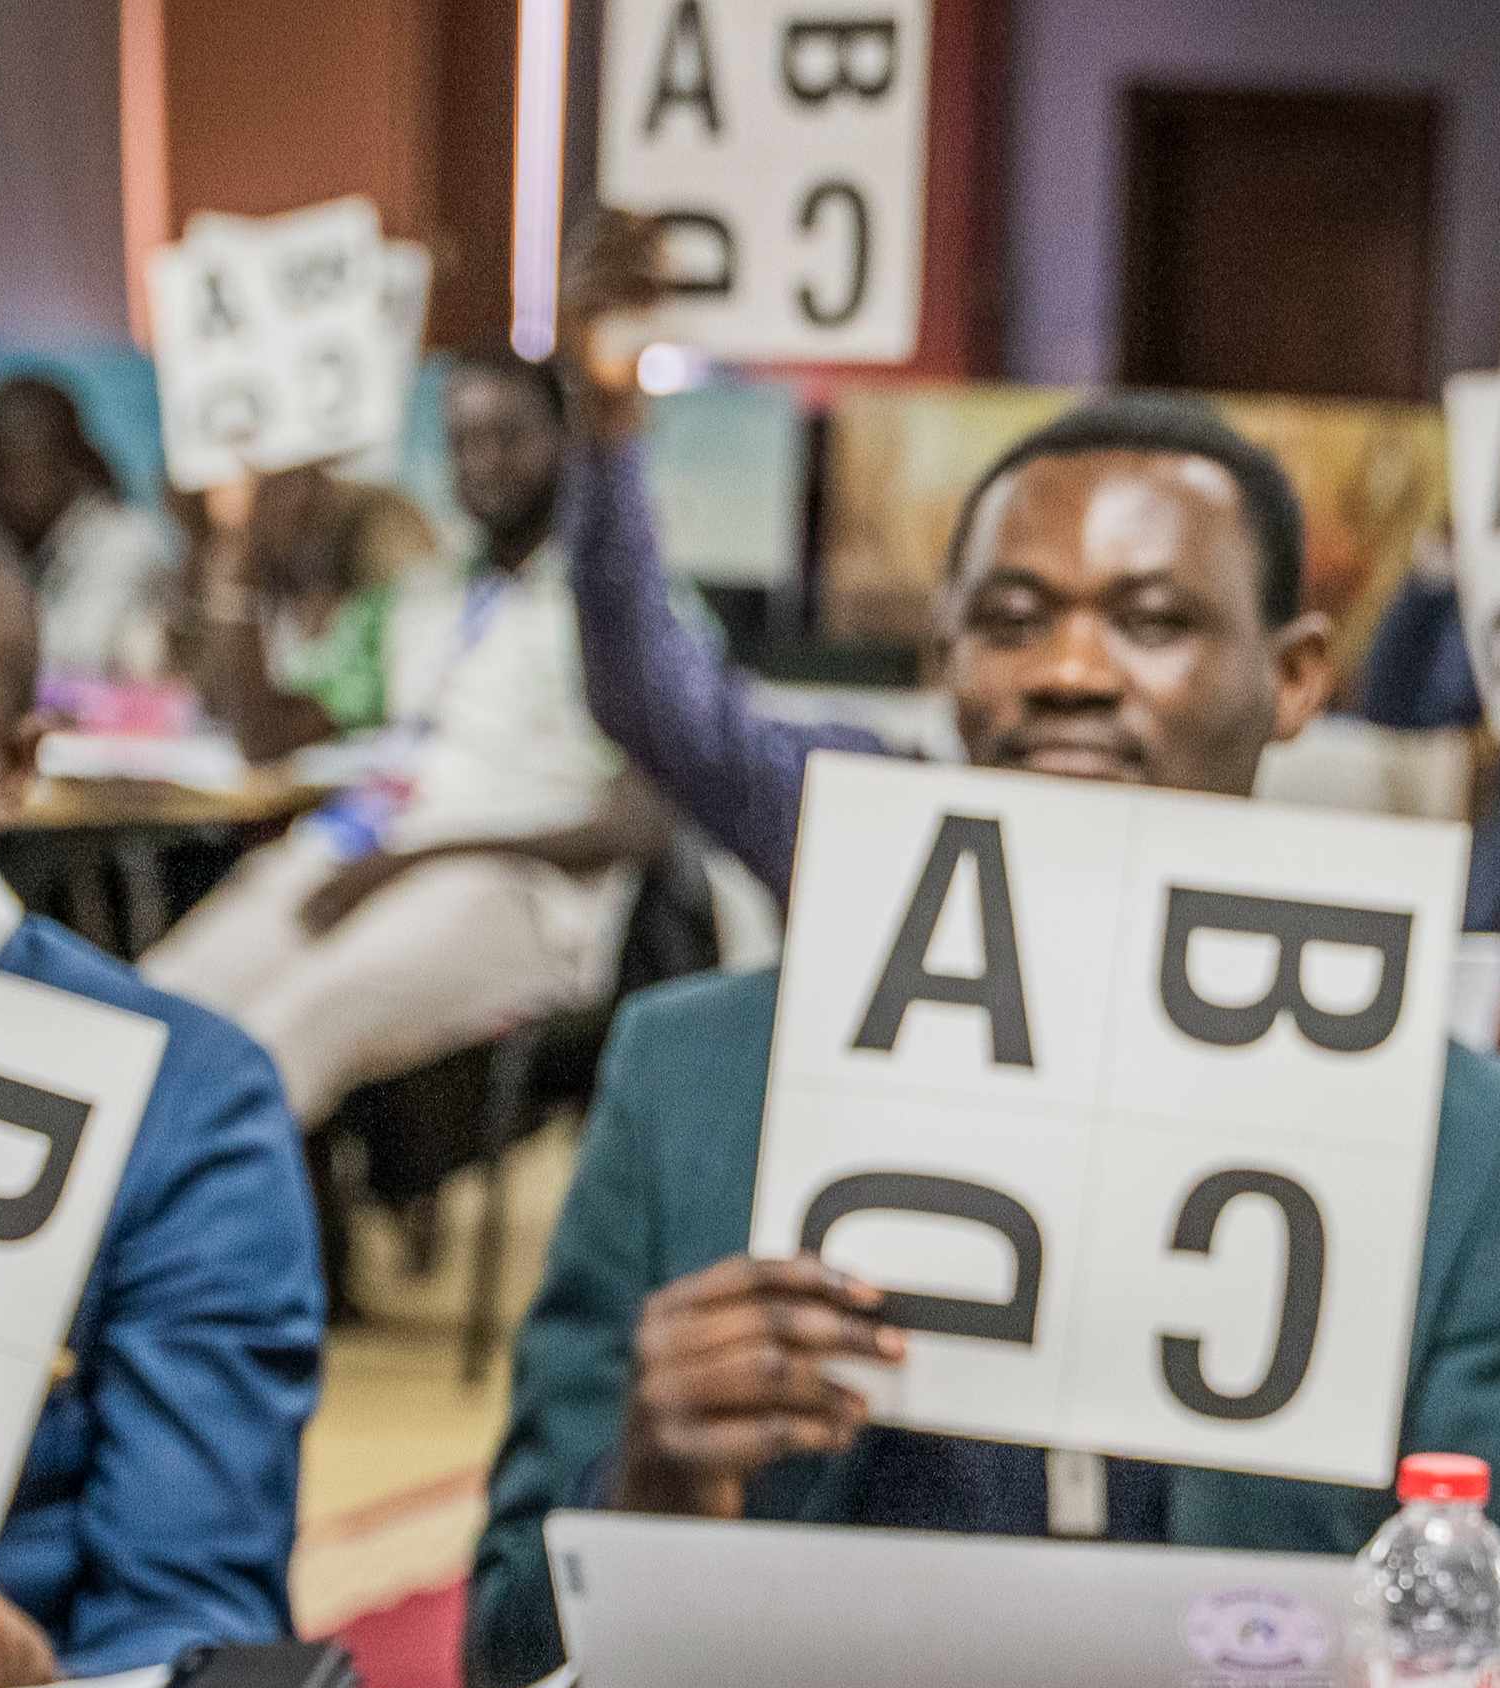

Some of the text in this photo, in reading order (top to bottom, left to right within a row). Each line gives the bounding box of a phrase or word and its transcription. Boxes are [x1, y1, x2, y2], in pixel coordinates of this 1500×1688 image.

[642, 0, 724, 137] A
[781, 17, 899, 108] B
[795, 178, 874, 331] C
[849, 812, 1036, 1069] A
[1157, 884, 1415, 1055] B
[797, 1170, 1044, 1349] D
[1155, 1168, 1327, 1423] C
